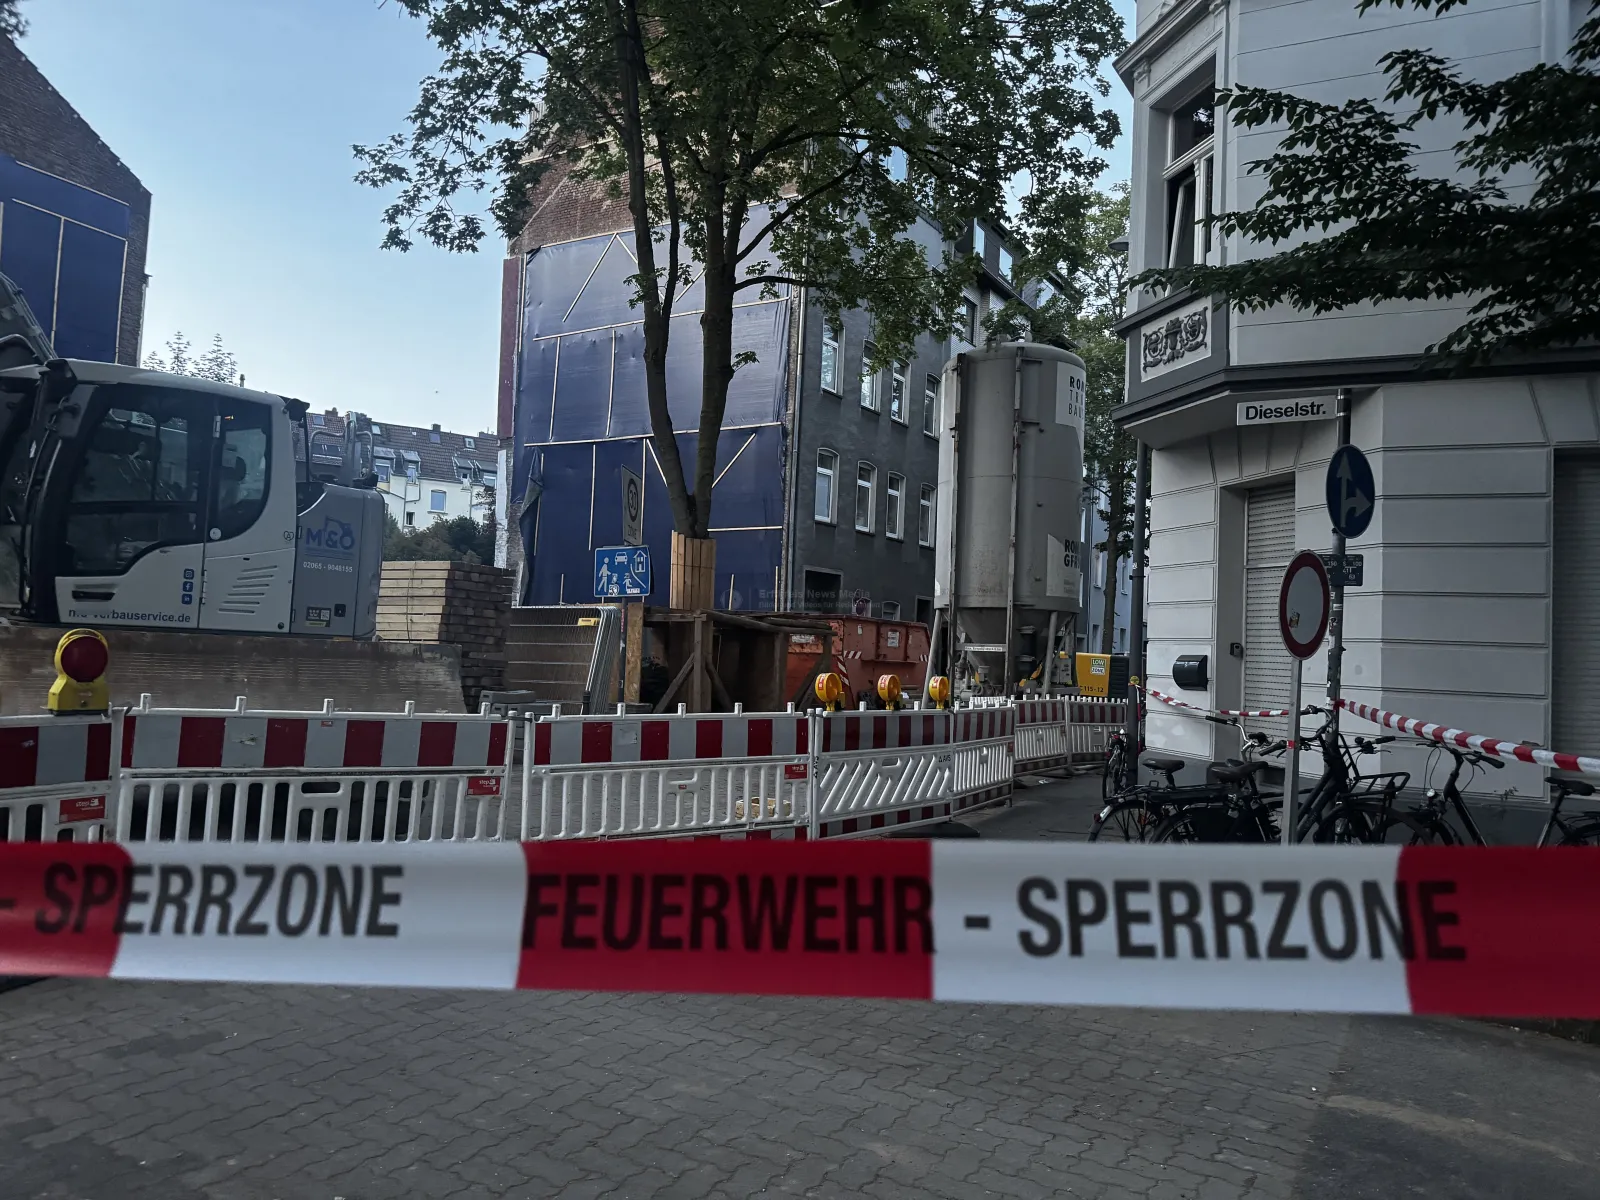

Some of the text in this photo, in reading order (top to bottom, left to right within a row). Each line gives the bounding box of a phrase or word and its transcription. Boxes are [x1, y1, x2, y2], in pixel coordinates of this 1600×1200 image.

[1245, 401, 1326, 420] Dieselstr.
[35, 862, 404, 937] SPERRZONE
[522, 873, 937, 954] FEUERWEHR
[964, 915, 990, 929] -
[1017, 876, 1467, 961] SPERRZONE
